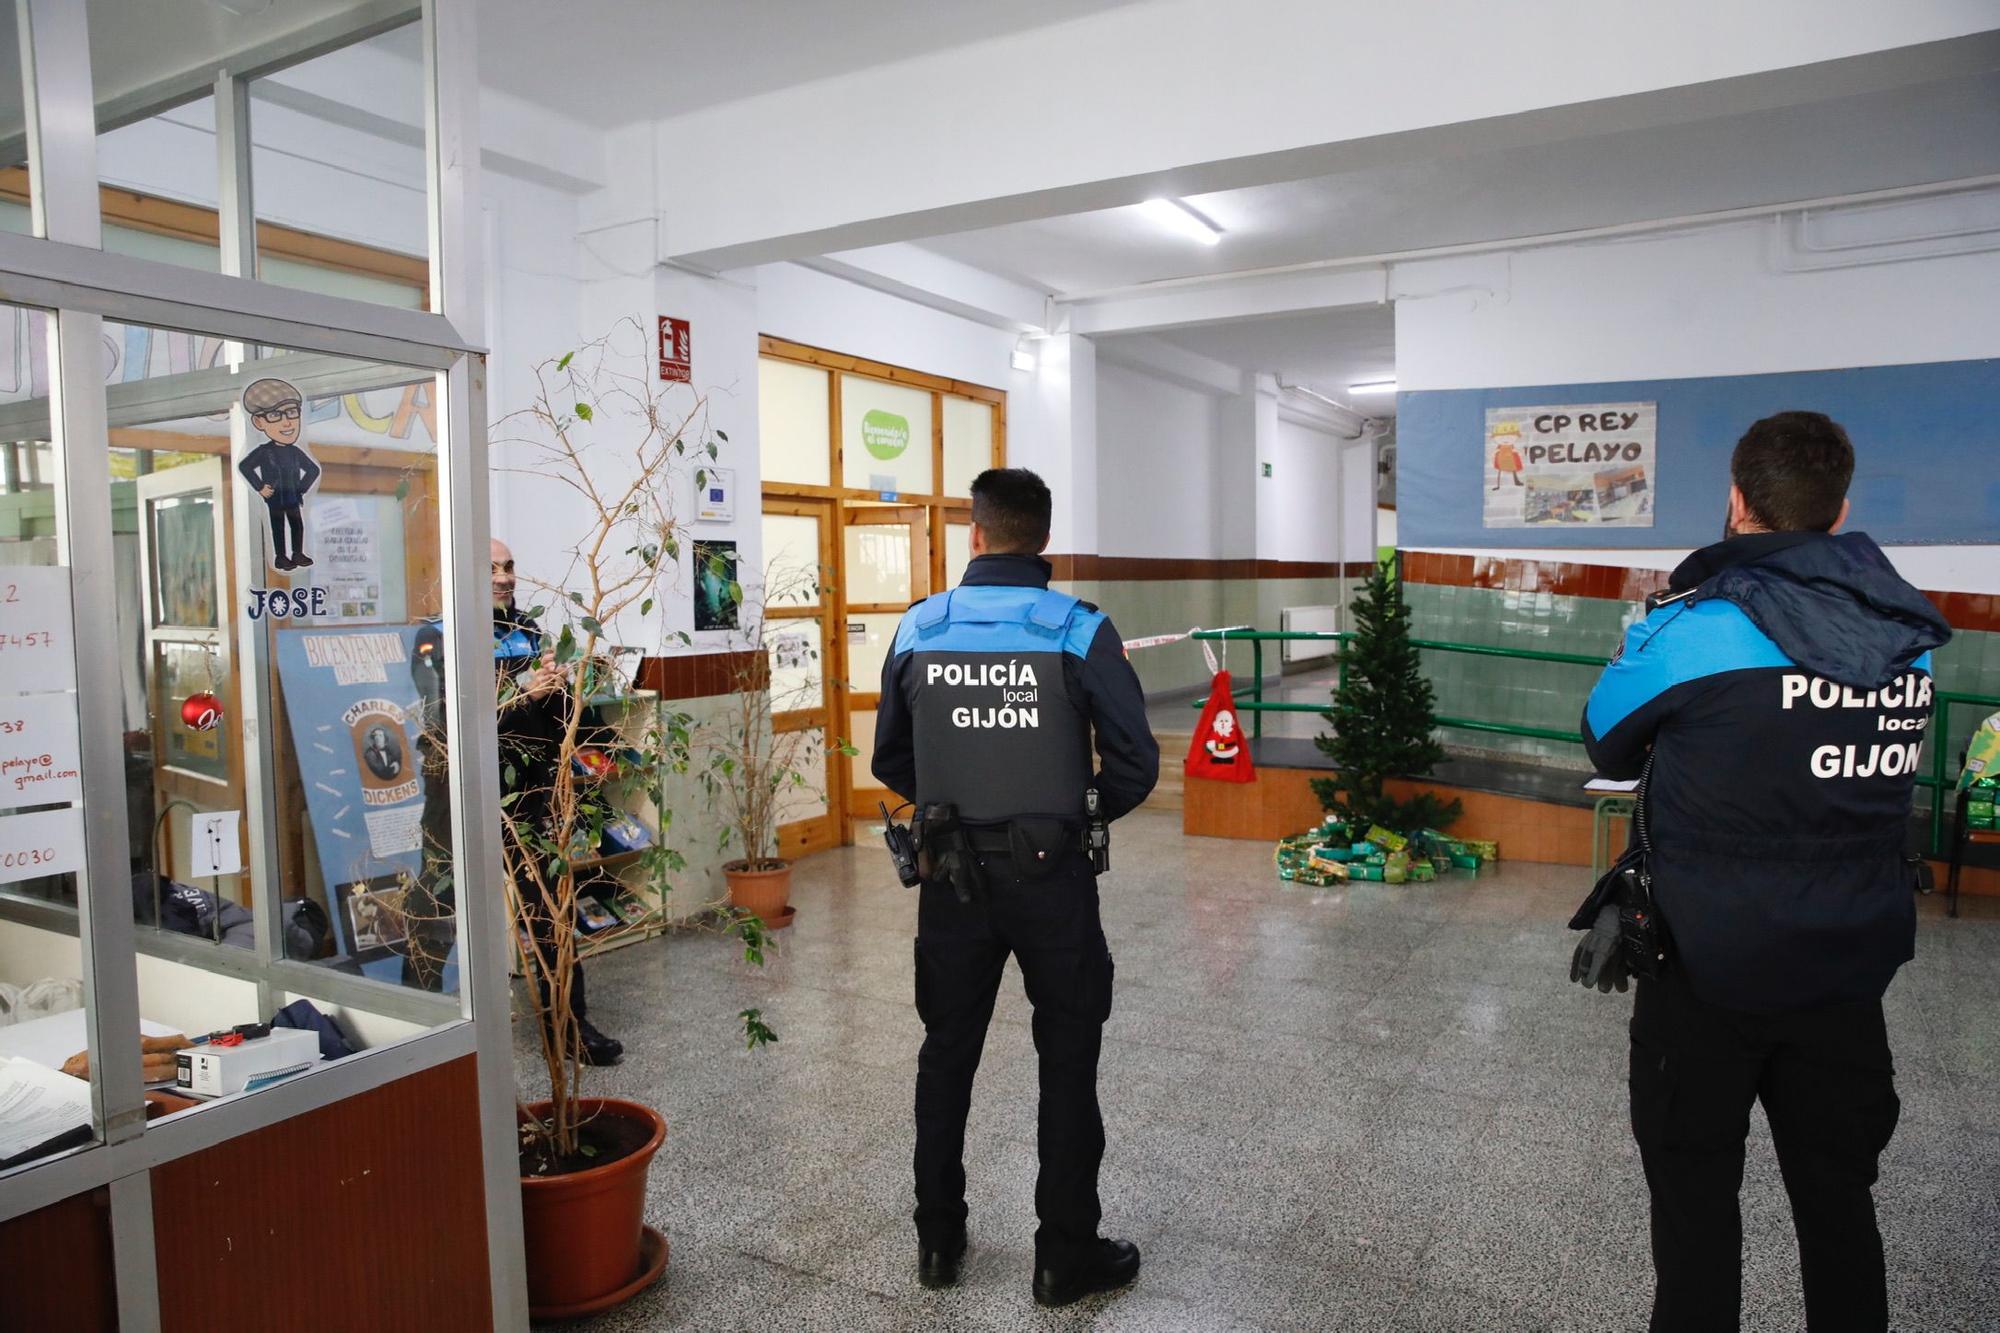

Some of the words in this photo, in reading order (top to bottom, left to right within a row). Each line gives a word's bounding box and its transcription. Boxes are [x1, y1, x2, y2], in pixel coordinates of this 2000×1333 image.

[1534, 414, 1571, 434] CP
[1579, 412, 1638, 432] REY
[1528, 442, 1642, 464] PELAYO
[248, 587, 327, 620] JOSE
[306, 633, 405, 665] BICENTENARIO
[927, 659, 1038, 686] POLICÍA
[1003, 688, 1038, 702] local
[952, 703, 1039, 728] GIJÓN
[14, 769, 78, 790] gmail.com
[363, 780, 419, 804] DICKENS
[0, 848, 55, 867] 0030
